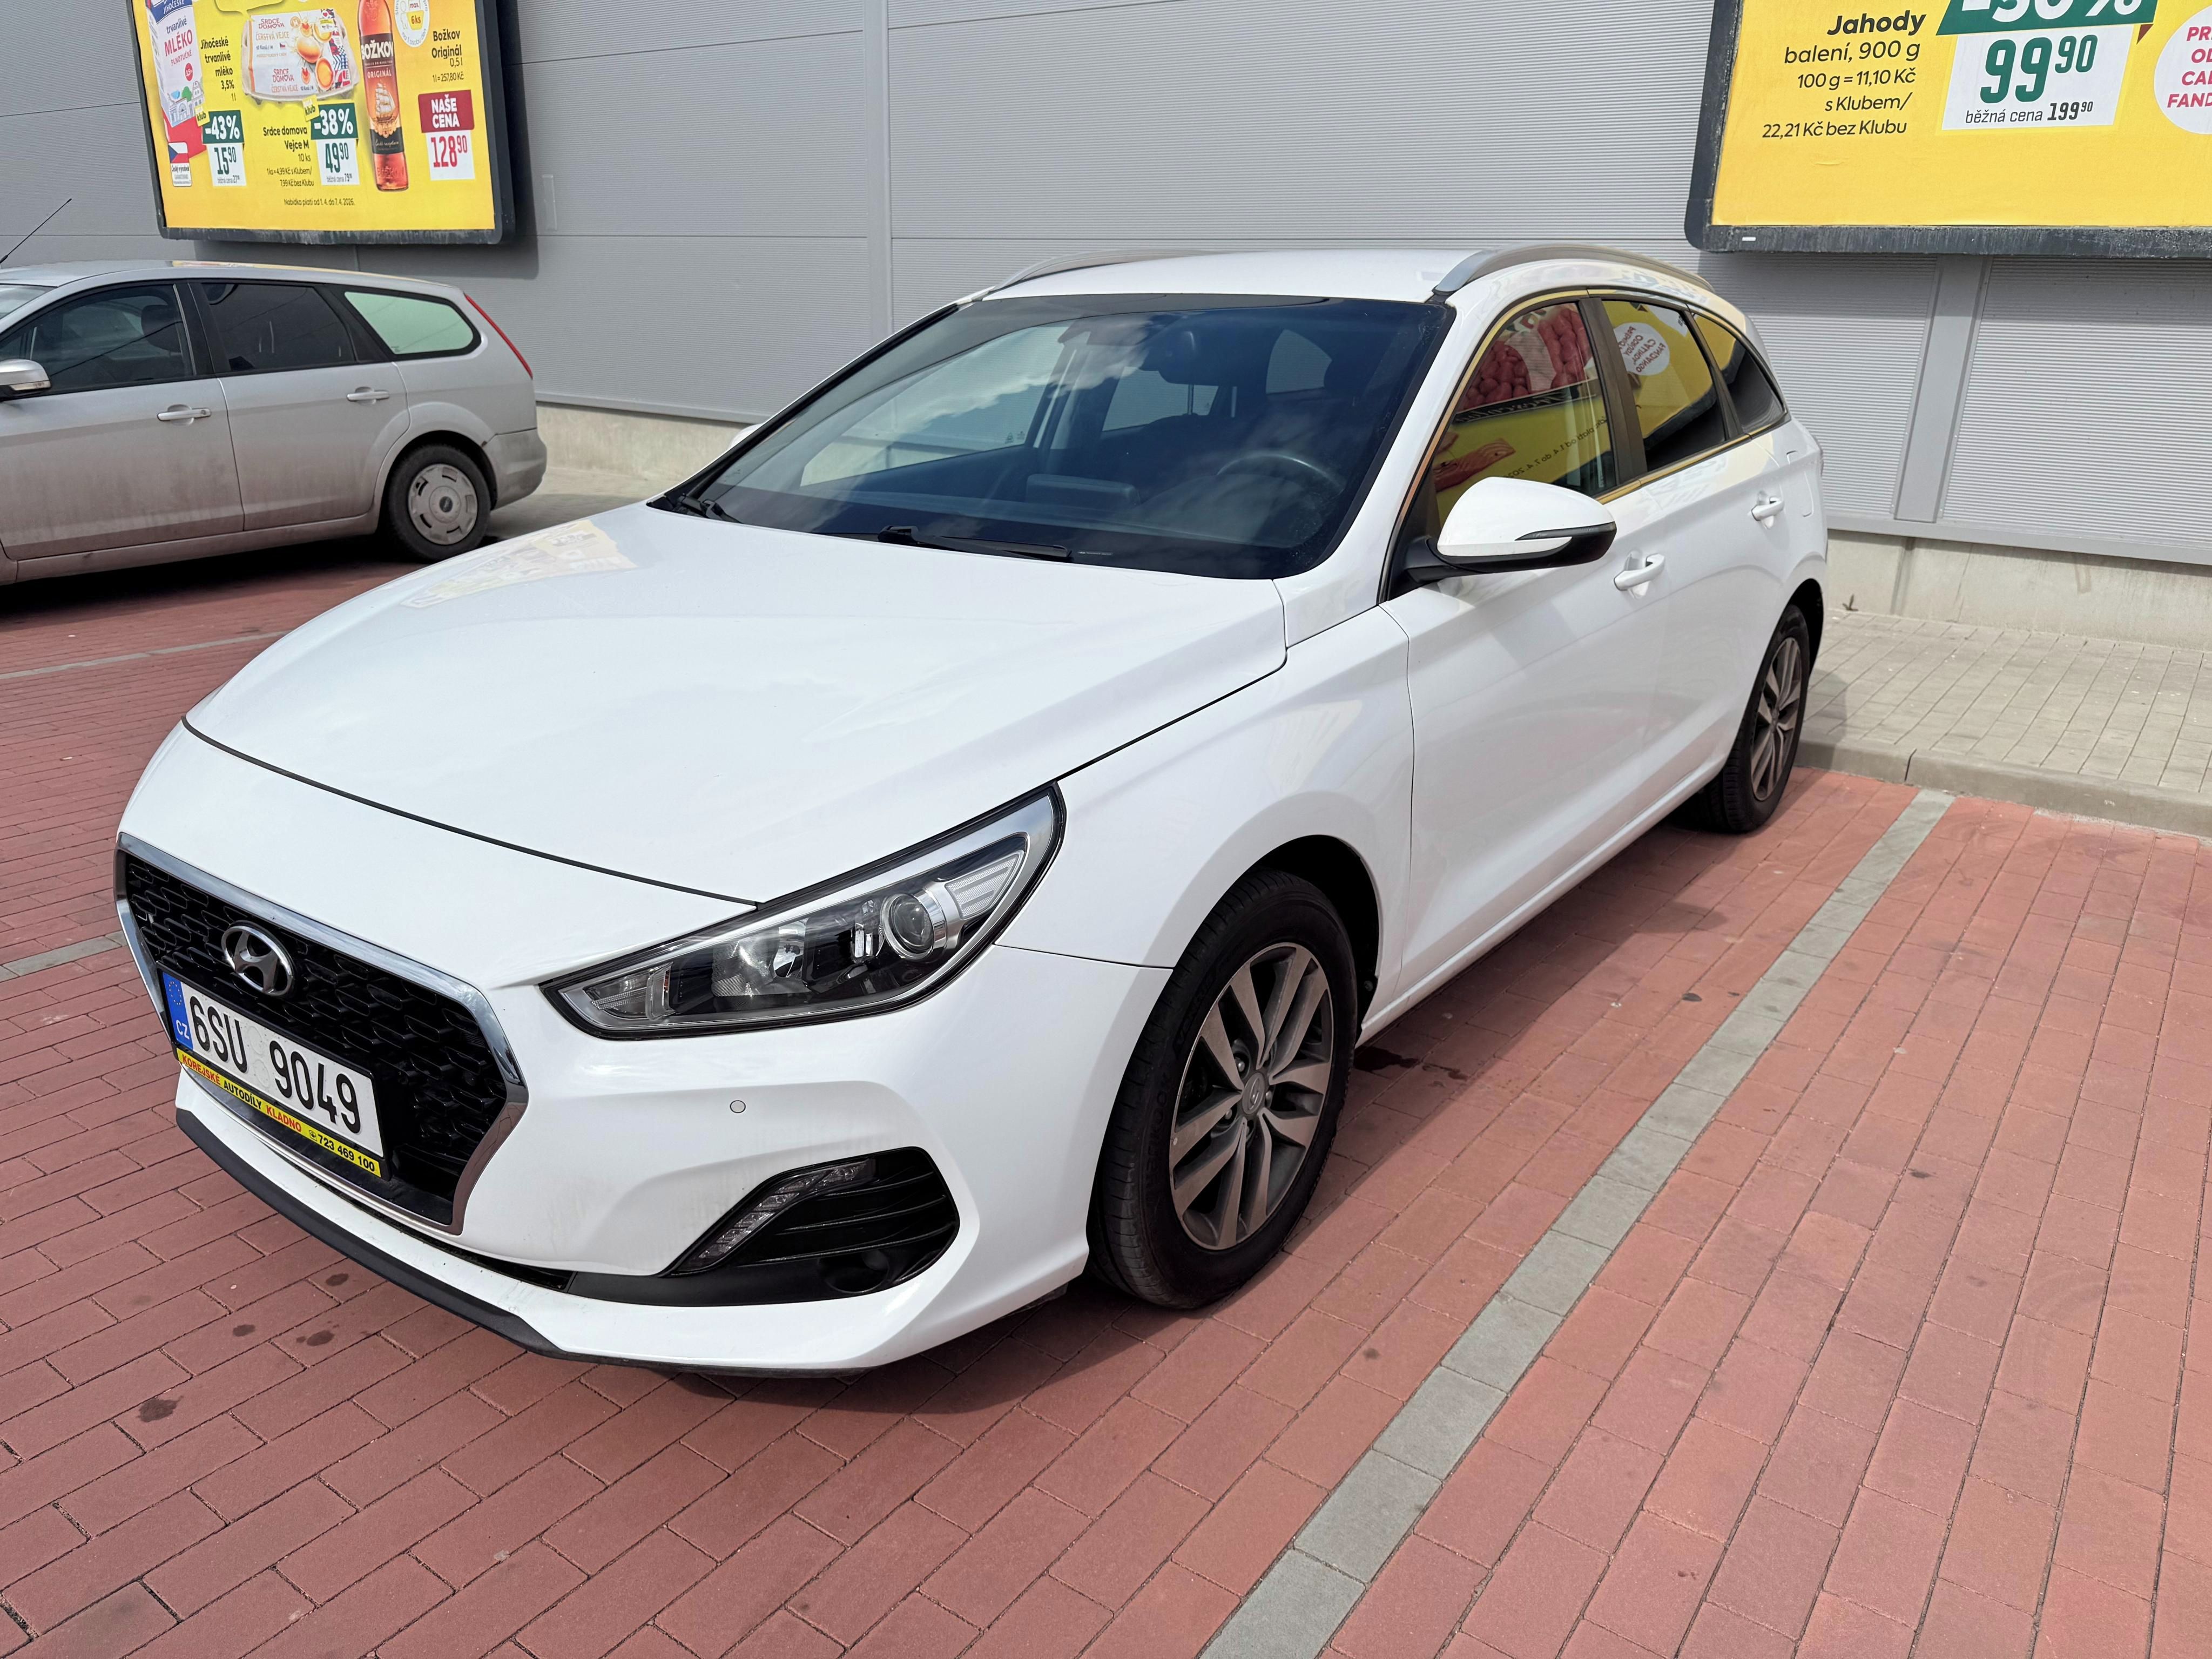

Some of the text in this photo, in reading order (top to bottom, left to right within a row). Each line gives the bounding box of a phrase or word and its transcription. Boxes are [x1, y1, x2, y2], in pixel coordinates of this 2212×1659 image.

[411, 15, 421, 24] 6 ks
[1826, 10, 1927, 36] Jahody
[433, 29, 460, 41] Božkov
[2187, 26, 2212, 42] PR
[164, 29, 193, 57] MLÉKO
[201, 36, 229, 50] Jihočeské
[205, 50, 231, 63] trvanlivé
[432, 44, 462, 59] Originál
[1784, 40, 1920, 64] balení, 900 g
[450, 58, 460, 68] 0,5
[215, 66, 233, 77] mléko
[367, 68, 392, 79] ORIGINÁL
[457, 72, 464, 81] Kč
[1797, 73, 1826, 89] 100
[1829, 75, 1840, 91] g
[1856, 69, 1891, 87] 11,10
[1893, 67, 1917, 84] Kč
[220, 80, 234, 91] 3,5%
[431, 94, 457, 113] NAŠE
[1825, 92, 1913, 111] s Klubem/
[304, 104, 316, 116] klub
[1965, 109, 2005, 124] běžná
[2009, 110, 2043, 123] cena
[205, 115, 240, 140] -43%
[314, 108, 354, 136] -38%
[432, 113, 460, 129] CENA
[263, 125, 307, 136] Srdce domova
[1762, 119, 1907, 140] 22,21 Kč bez Klubu
[285, 139, 309, 152] Vejce M
[298, 153, 311, 162] 10 ks
[176, 1019, 190, 1041] CZ
[190, 995, 361, 1134] 6SU 9049
[181, 1054, 375, 1172] KOREJSKÉ AUTODÍLY KLADNO 723 469 100
